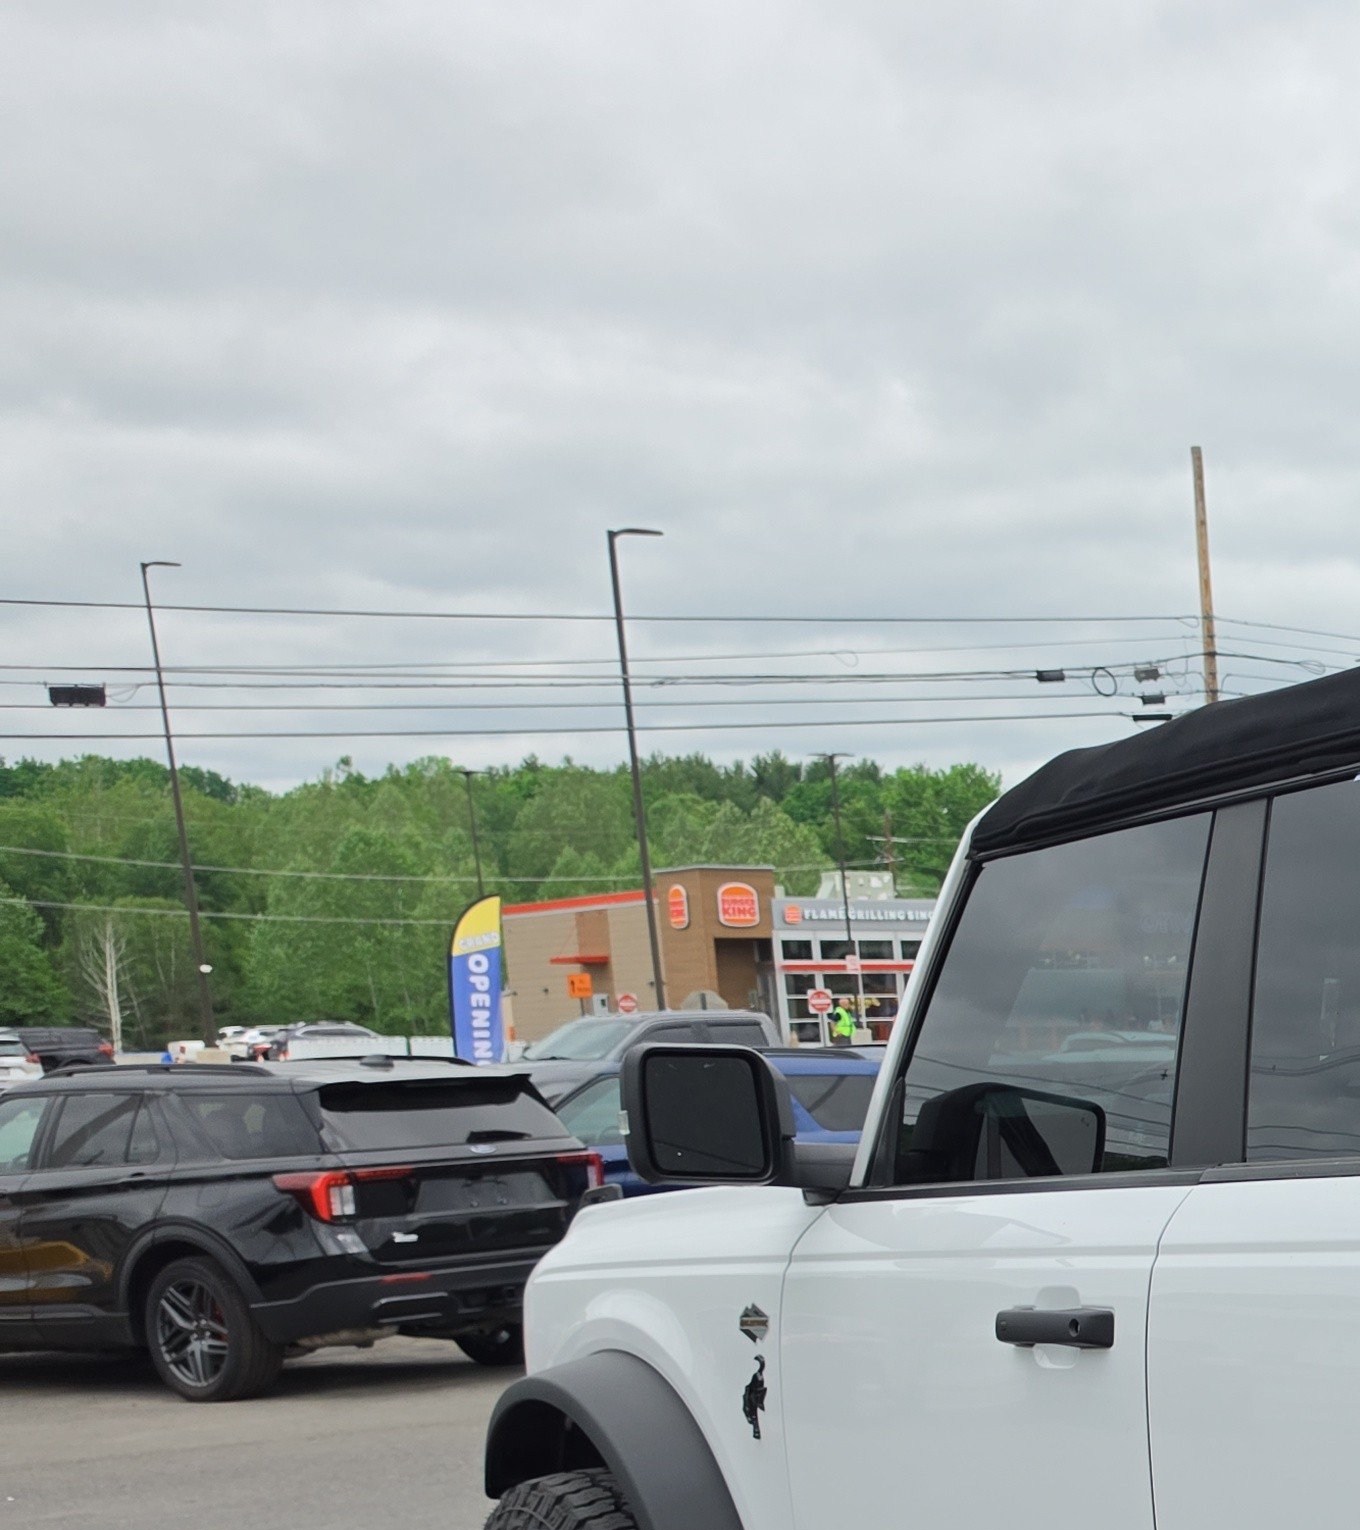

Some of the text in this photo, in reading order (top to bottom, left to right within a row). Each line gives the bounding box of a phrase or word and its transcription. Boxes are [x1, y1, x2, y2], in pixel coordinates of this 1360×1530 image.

[722, 906, 757, 917] KING
[804, 909, 847, 920] FLAME
[849, 909, 906, 920] GRILLING
[467, 953, 494, 1067] OPENIN
